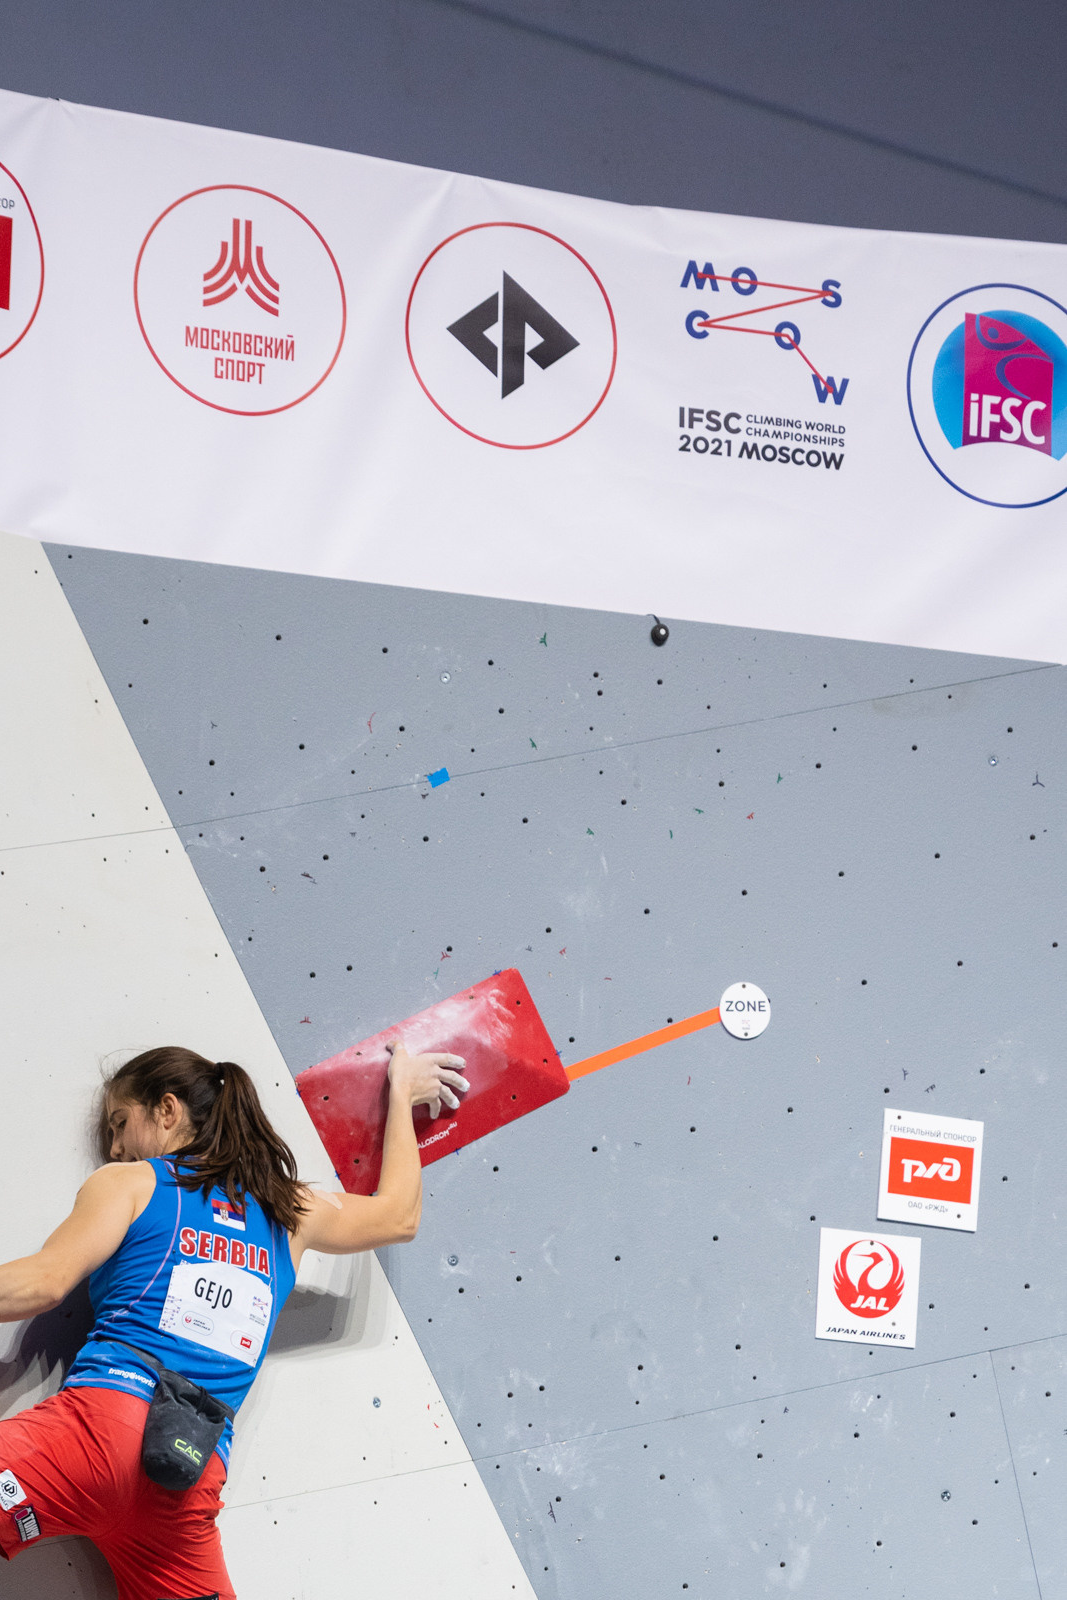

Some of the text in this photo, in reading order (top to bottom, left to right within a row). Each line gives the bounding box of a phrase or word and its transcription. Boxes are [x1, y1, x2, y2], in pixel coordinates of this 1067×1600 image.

[185, 325, 295, 362] МОСКОВСКИЙ
[214, 356, 266, 385] СПОРТ
[679, 406, 846, 435] IFSC CLIMBING WORLD
[746, 427, 845, 448] CHAMPIONSHIPS
[678, 434, 845, 470] 2021 MOSCOW
[725, 1000, 766, 1012] ZONE
[417, 1121, 458, 1149] ALODROM.RU
[889, 1124, 977, 1143] ГЕНЕРАЛЬНЫЙ СПОНСОР
[908, 1201, 949, 1213] ОАО «РЖД»
[179, 1227, 271, 1278] SERBIA
[194, 1277, 233, 1309] GEJO
[850, 1294, 890, 1311] JAL
[825, 1326, 906, 1340] JAPAN AIRLINES
[174, 1438, 203, 1464] CAC
